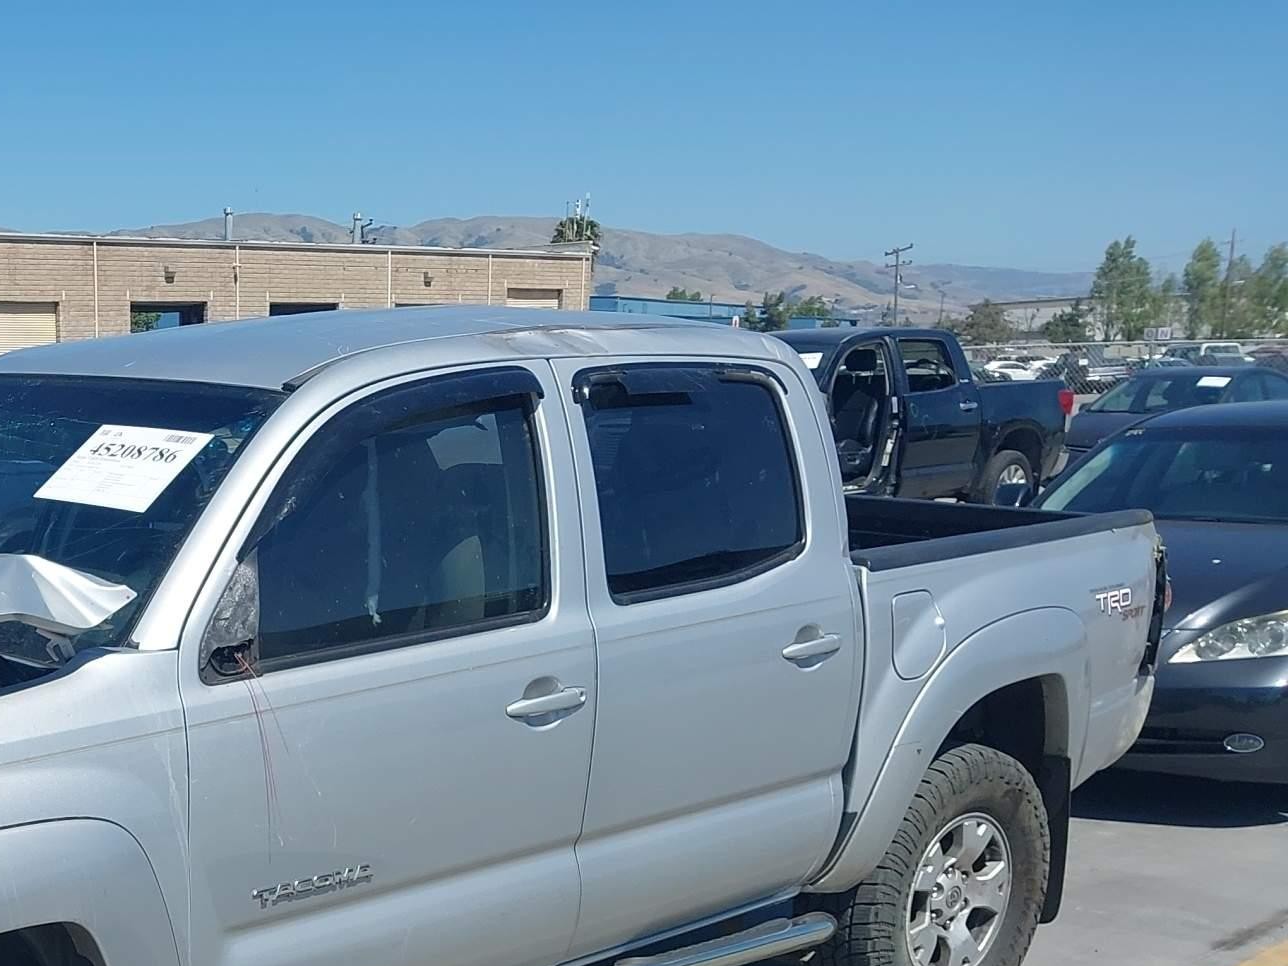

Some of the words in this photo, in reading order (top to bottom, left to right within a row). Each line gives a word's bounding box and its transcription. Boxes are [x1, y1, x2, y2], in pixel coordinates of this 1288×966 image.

[89, 441, 184, 464] 45208786
[1095, 587, 1132, 616] TRD
[1122, 606, 1146, 621] SPORT
[251, 864, 374, 909] TACOMA
